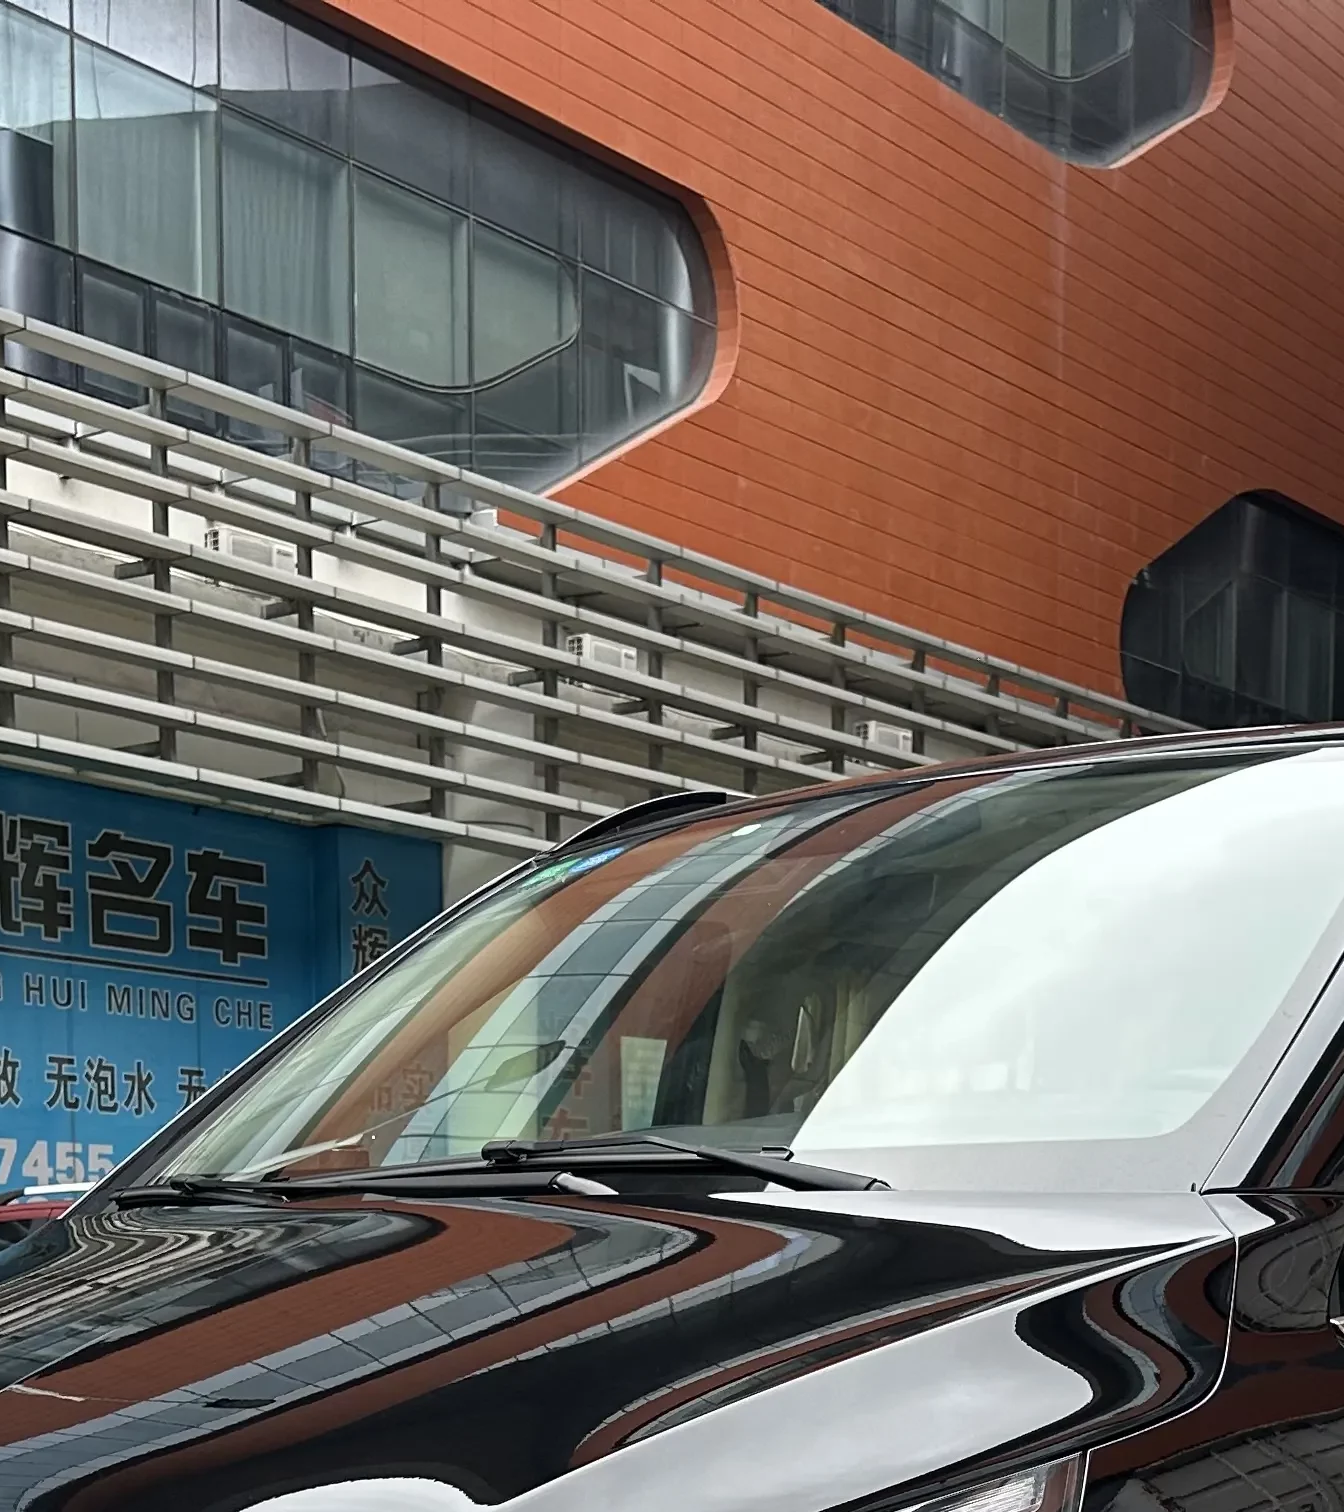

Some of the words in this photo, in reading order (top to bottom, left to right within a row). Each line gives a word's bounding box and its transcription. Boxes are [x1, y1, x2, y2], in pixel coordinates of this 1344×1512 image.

[24, 972, 87, 1011] HUI
[105, 983, 196, 1023] MING
[213, 996, 274, 1032] CHE
[45, 1054, 157, 1118] 无泡水
